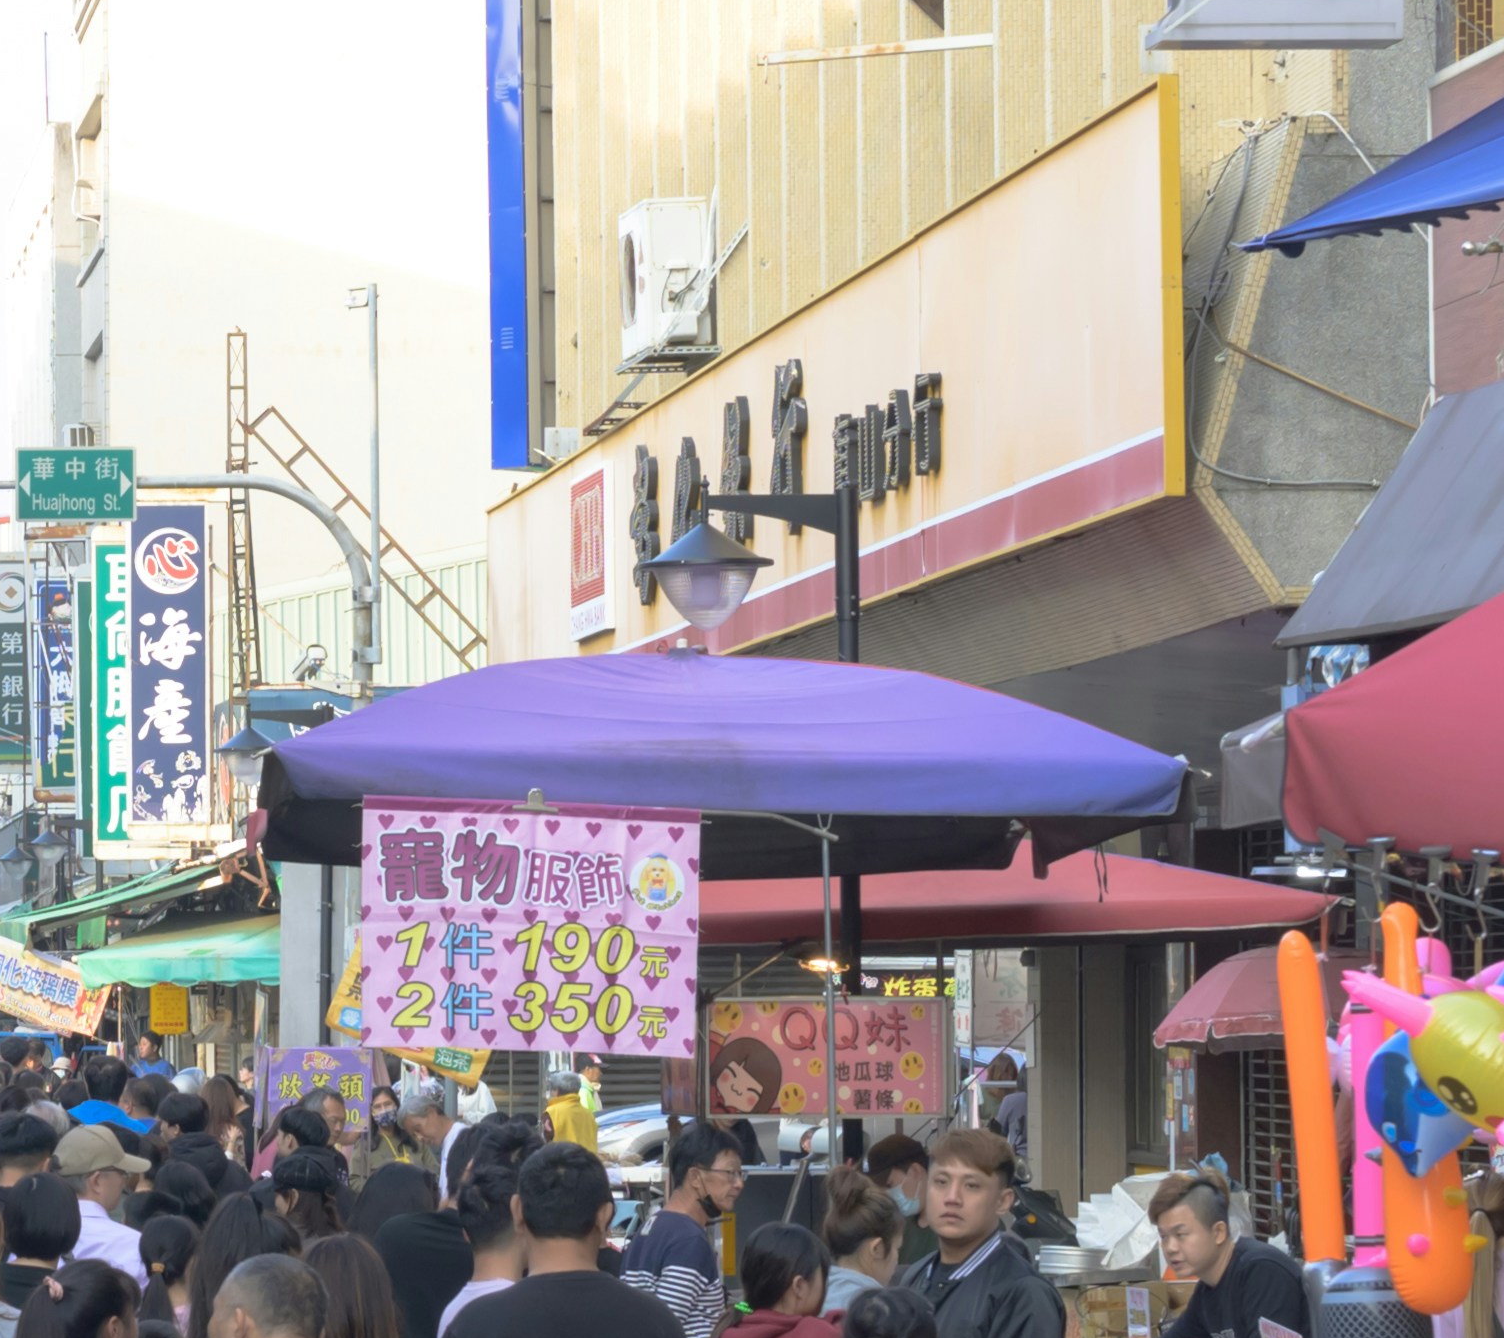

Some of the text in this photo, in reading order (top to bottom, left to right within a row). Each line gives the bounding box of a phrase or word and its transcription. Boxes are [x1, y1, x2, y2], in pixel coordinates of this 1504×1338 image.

[32, 457, 120, 480] 華中街
[32, 494, 121, 515] Huajhong St.
[1, 631, 24, 726] 第一銀行
[138, 606, 202, 745] 海產
[380, 829, 624, 908] 寵物服飾
[396, 922, 670, 980] 1件 190元
[392, 983, 493, 1030] 2件
[508, 984, 667, 1039] 350元
[780, 1006, 910, 1052] QQ妹
[437, 1048, 472, 1071] 泡茶
[834, 1061, 894, 1082] 地瓜球
[853, 1089, 894, 1111] 薯條
